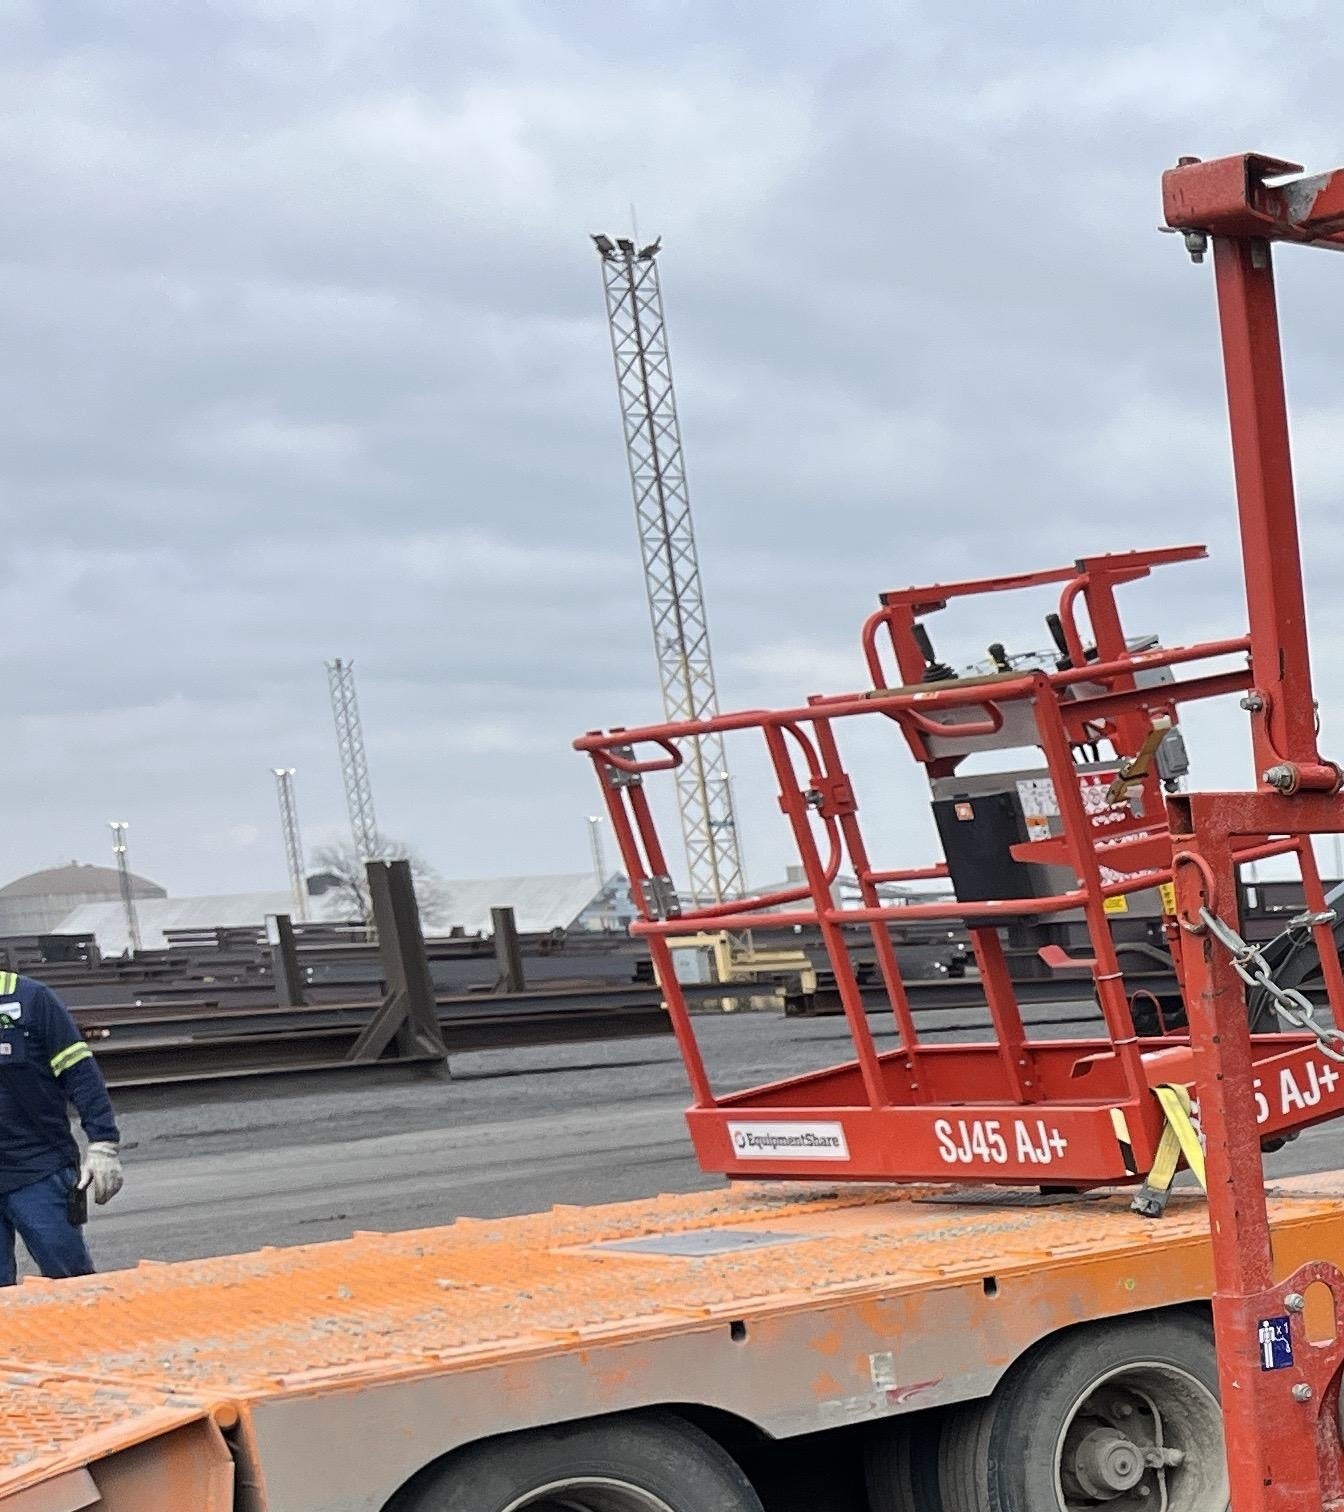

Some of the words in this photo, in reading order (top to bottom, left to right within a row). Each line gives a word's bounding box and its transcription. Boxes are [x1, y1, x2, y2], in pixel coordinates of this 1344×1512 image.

[1280, 1061, 1339, 1115] AJ+
[746, 1132, 840, 1149] EquipmentShare
[934, 1119, 1008, 1163] SJ45
[1015, 1119, 1068, 1164] AJ+
